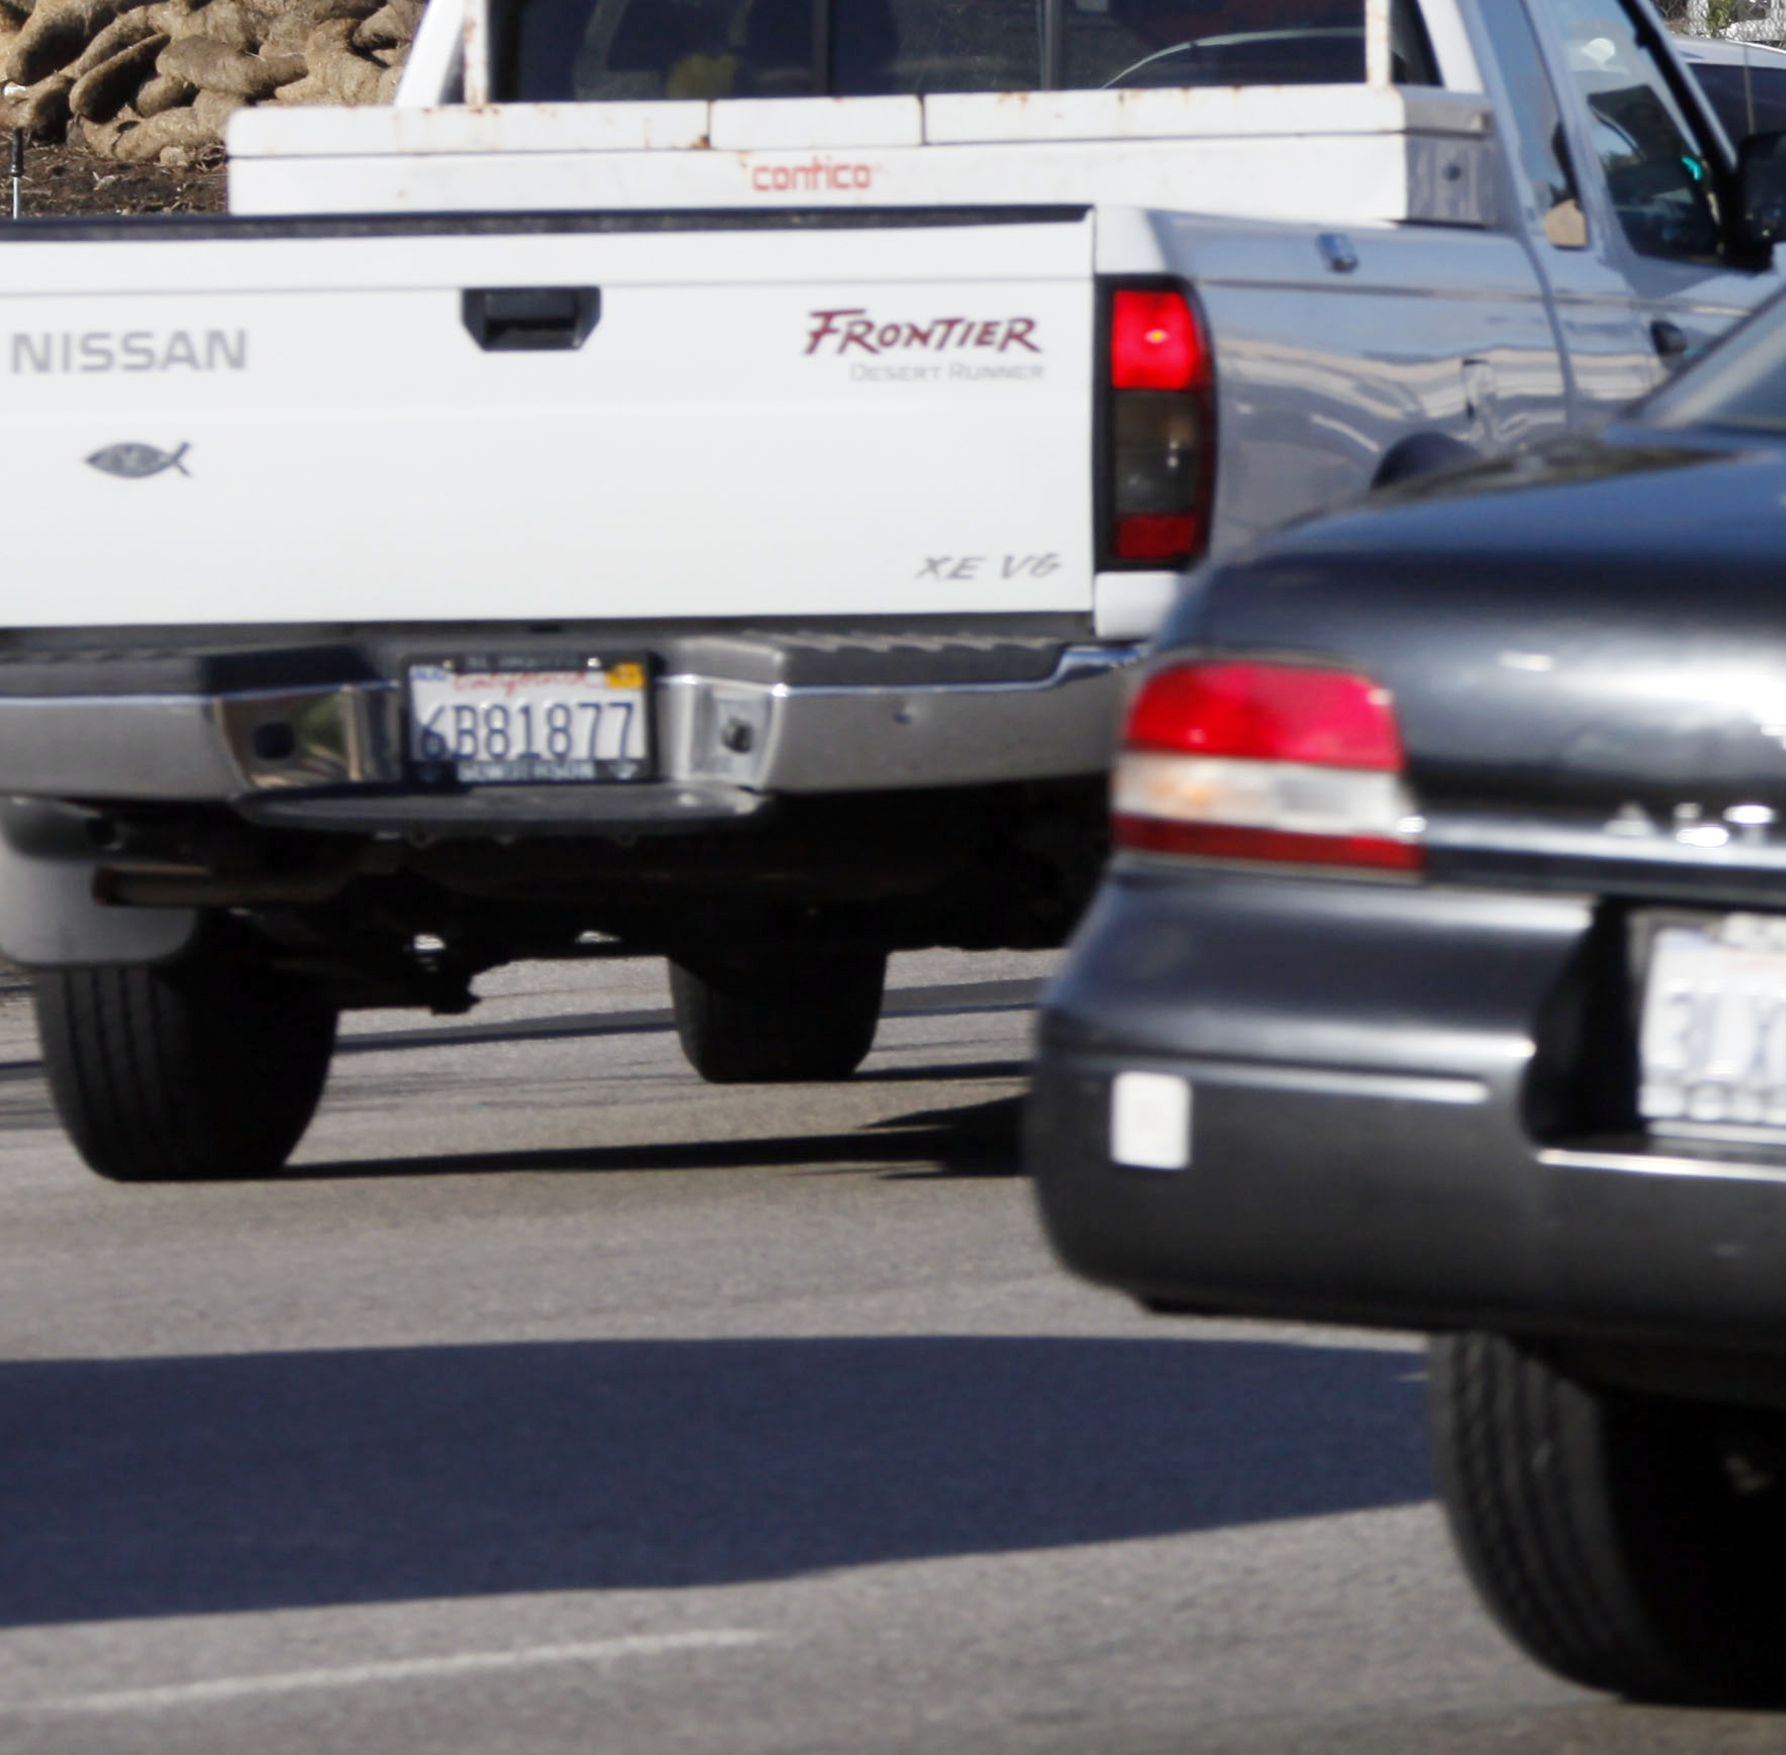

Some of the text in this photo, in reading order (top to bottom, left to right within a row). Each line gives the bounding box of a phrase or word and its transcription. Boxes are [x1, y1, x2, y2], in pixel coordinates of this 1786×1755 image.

[753, 155, 872, 191] contico
[11, 329, 247, 374] NISSAN
[804, 308, 1043, 356] FRONTIER
[850, 362, 1043, 382] DESERT RUNNER
[915, 551, 1063, 581] XE V6
[420, 702, 633, 758] 6B81877
